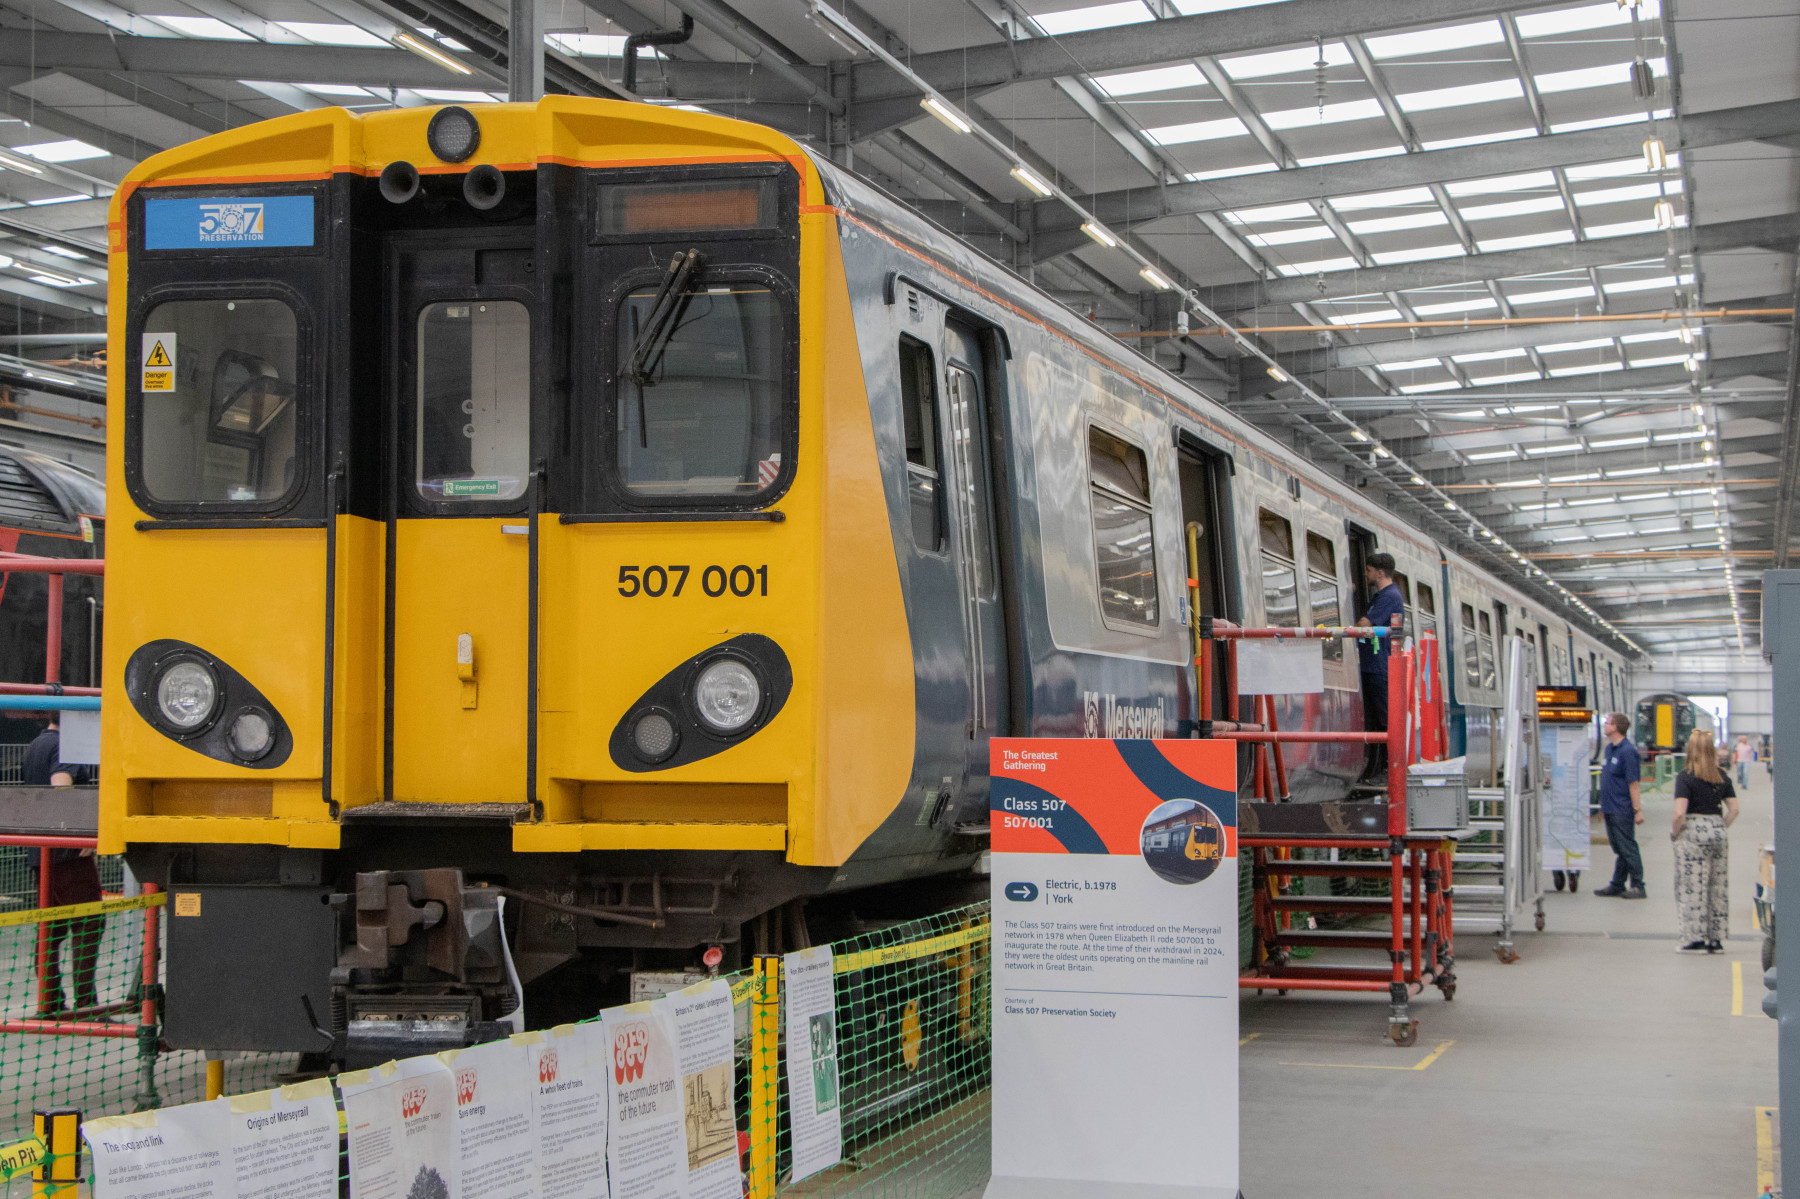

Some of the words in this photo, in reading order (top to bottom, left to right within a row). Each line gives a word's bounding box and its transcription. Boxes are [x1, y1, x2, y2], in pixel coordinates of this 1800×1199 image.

[199, 208, 261, 234] 507
[199, 233, 264, 242] PRESERVATION
[145, 371, 167, 379] Danger
[618, 565, 690, 598] 507
[702, 564, 768, 598] 001
[1003, 750, 1019, 760] The
[1021, 750, 1058, 760] Greatest
[1003, 760, 1046, 772] Gathering
[1004, 797, 1038, 811] Class
[1042, 799, 1067, 811] 507
[1004, 816, 1054, 829] 507001
[1046, 879, 1082, 891] Electric,
[1084, 879, 1117, 891] b.1978
[1052, 893, 1074, 904] York
[1004, 920, 1018, 929] The
[1019, 920, 1039, 930] Class
[1040, 922, 1055, 930] 507
[1056, 921, 1078, 931] trains
[1079, 923, 1098, 931] were
[1099, 922, 1114, 932] first
[1116, 923, 1155, 933] introduced
[1156, 925, 1167, 933] on
[1168, 924, 1181, 934] the
[1182, 925, 1222, 936] Merseyrail
[1004, 931, 1035, 940] network
[1036, 931, 1044, 940] in
[1045, 932, 1064, 940] 1978
[1066, 931, 1087, 941] when
[1088, 932, 1113, 942] Queen
[1114, 933, 1148, 943] Elizabeth
[1157, 935, 1174, 944] rode
[1176, 936, 1205, 944] 507001
[1206, 937, 1215, 945] to
[1004, 942, 1044, 951] inaugurate
[1045, 942, 1058, 950] the
[1059, 942, 1081, 951] route.
[1082, 943, 1091, 952] At
[1092, 942, 1105, 952] the
[1106, 943, 1124, 953] time
[1125, 944, 1133, 953] of
[1134, 944, 1152, 954] their
[1154, 946, 1192, 955] withdrawl
[1194, 946, 1201, 955] in
[1203, 948, 1225, 957] 2024,
[1004, 952, 1020, 961] they
[1022, 952, 1041, 960] were
[1042, 952, 1054, 961] the
[1056, 952, 1078, 962] oldest
[1080, 954, 1098, 962] units
[1099, 954, 1135, 964] operating
[1136, 956, 1146, 964] on
[1148, 956, 1160, 964] the
[1162, 956, 1195, 965] mainline
[1196, 957, 1209, 966] rail
[1004, 962, 1035, 970] network
[1036, 962, 1044, 970] in
[1045, 962, 1066, 972] Great
[1067, 964, 1094, 972] Britain.
[1004, 997, 1028, 1005] Courtesy
[1004, 1005, 1024, 1014] Class
[1025, 1007, 1040, 1015] 507
[1042, 1006, 1088, 1016] Preservation
[1089, 1008, 1117, 1019] Society
[618, 1088, 629, 1104] the
[629, 1084, 659, 1103] commuter
[660, 1077, 676, 1094] train
[470, 1104, 486, 1116] energy
[620, 1107, 627, 1122] of
[628, 1103, 638, 1119] the
[638, 1100, 657, 1116] future
[247, 1116, 269, 1130] Origins
[270, 1113, 276, 1124] of
[276, 1106, 309, 1122] Merseyrail
[412, 1116, 430, 1127] commuter
[430, 1112, 442, 1120] train
[416, 1124, 426, 1133] future
[103, 1142, 120, 1154] The
[121, 1141, 136, 1152] loop
[136, 1138, 150, 1150] and
[150, 1134, 164, 1148] link
[18, 1147, 38, 1167] Pit
